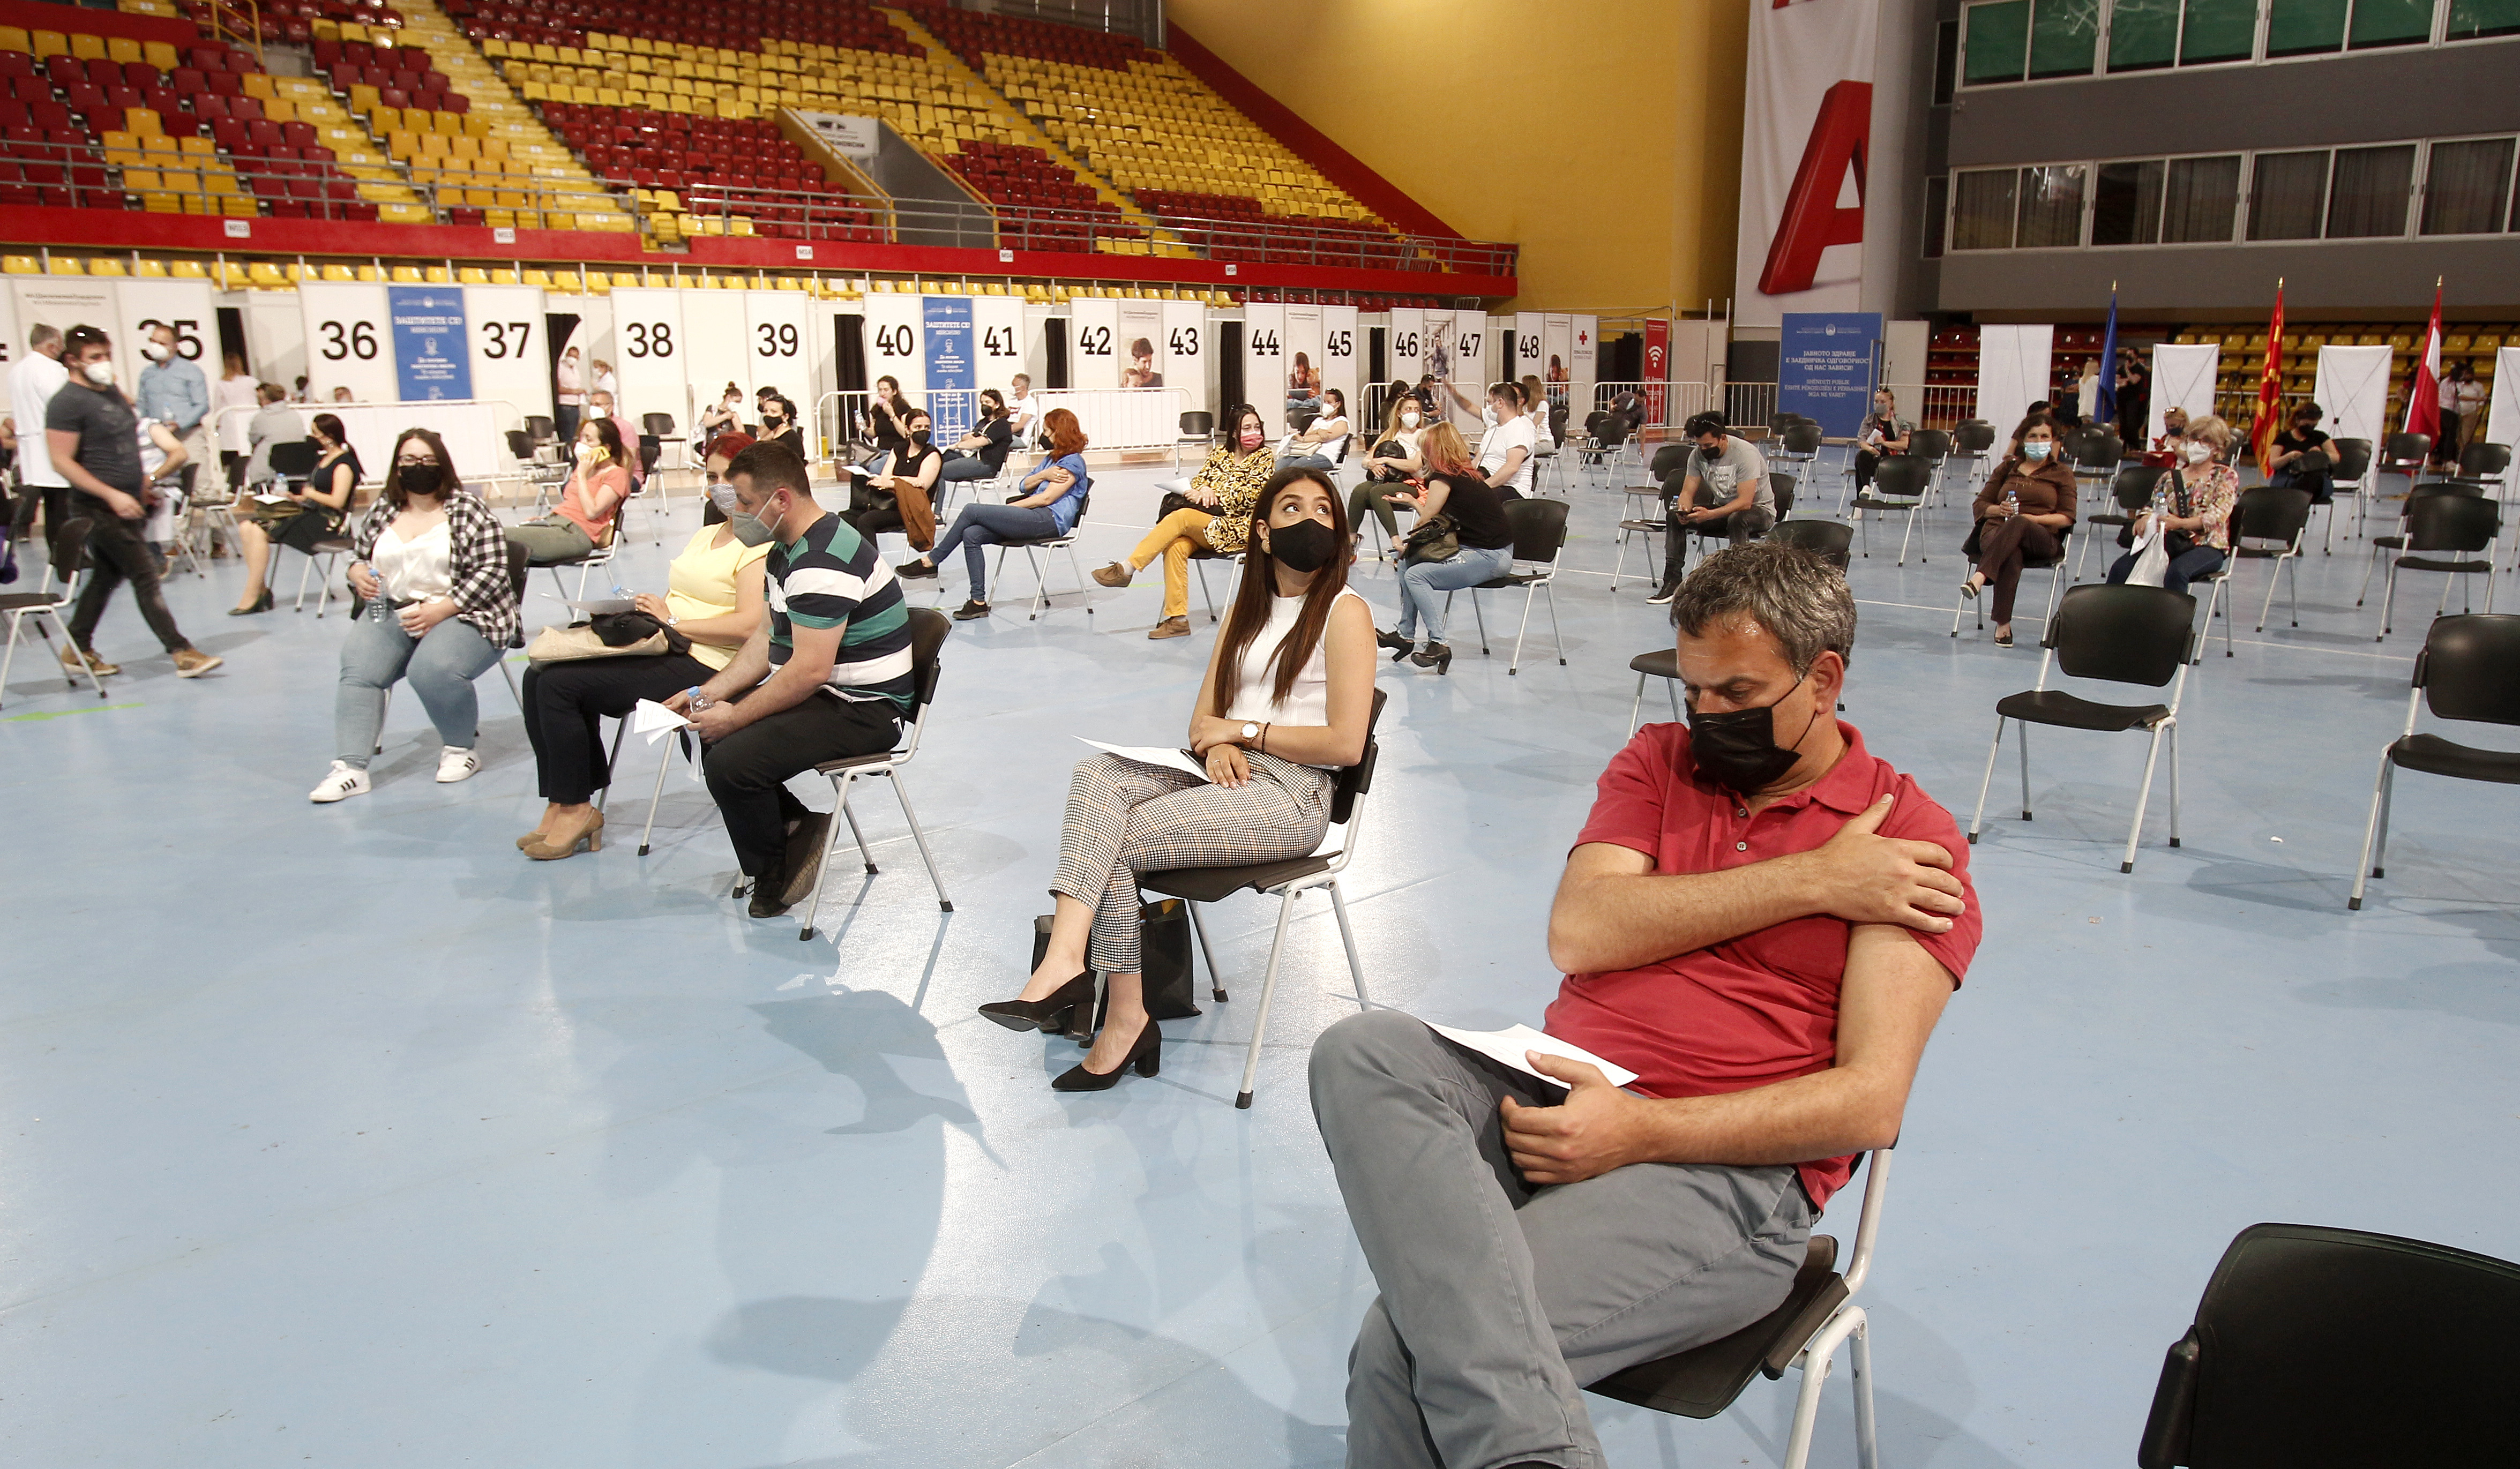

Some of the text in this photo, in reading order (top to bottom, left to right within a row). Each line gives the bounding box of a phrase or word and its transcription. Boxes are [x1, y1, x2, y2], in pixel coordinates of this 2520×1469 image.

[320, 321, 377, 360] 36
[483, 322, 530, 359] 37
[627, 323, 673, 358] 38
[758, 323, 798, 357] 39
[876, 325, 913, 356] 40
[984, 326, 1017, 356] 41
[1080, 326, 1111, 355] 42
[1170, 327, 1198, 356] 43
[1252, 329, 1280, 356] 44
[1327, 331, 1352, 357] 45
[1395, 332, 1418, 357] 46
[1459, 333, 1481, 357] 47
[1519, 335, 1539, 359] 48
